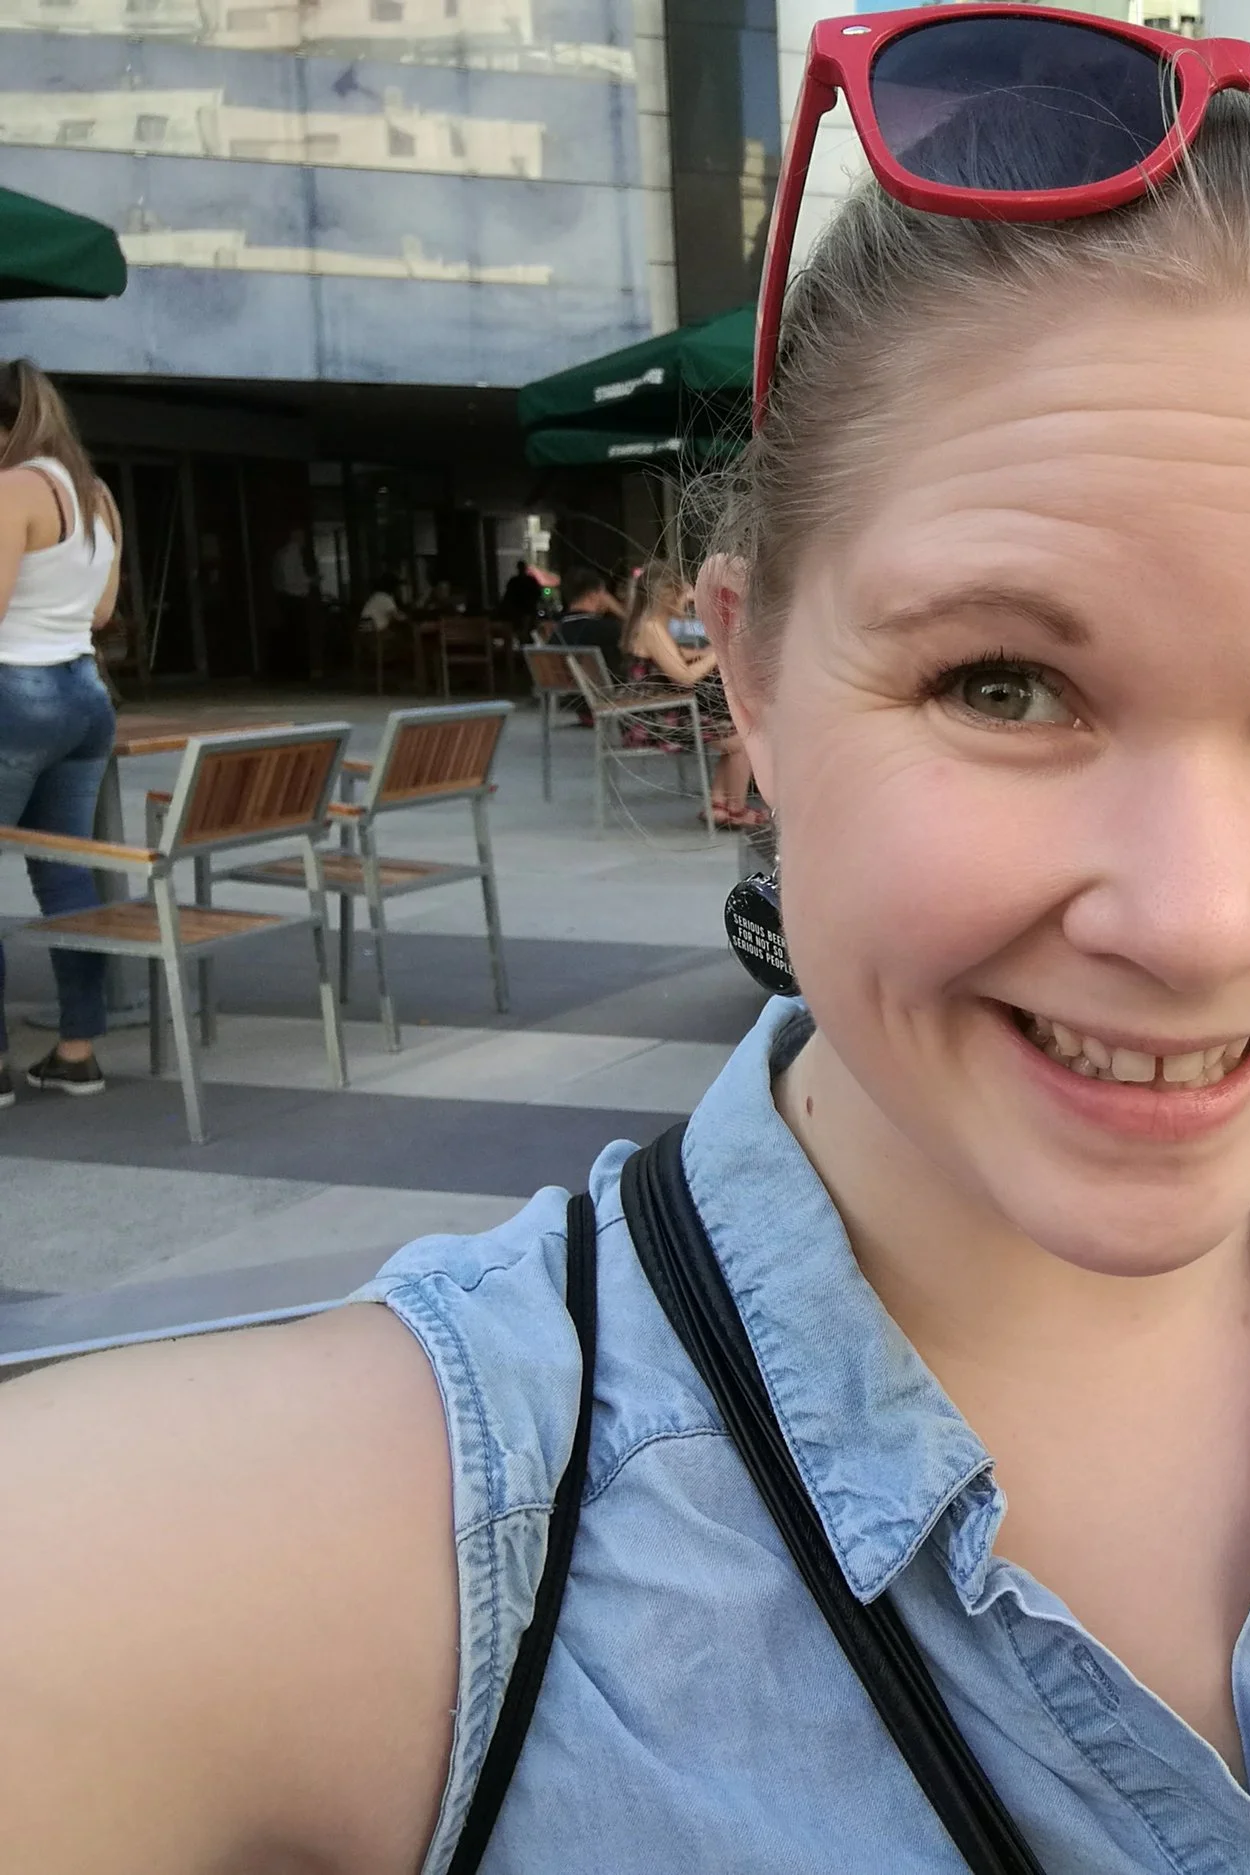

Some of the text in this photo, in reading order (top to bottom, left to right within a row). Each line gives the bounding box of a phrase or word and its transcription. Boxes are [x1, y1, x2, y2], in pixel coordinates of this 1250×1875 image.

[733, 913, 765, 937] SERIOUS
[732, 935, 795, 977] SERIOUS PEOPLE
[738, 927, 783, 959] FOR NOT SO
